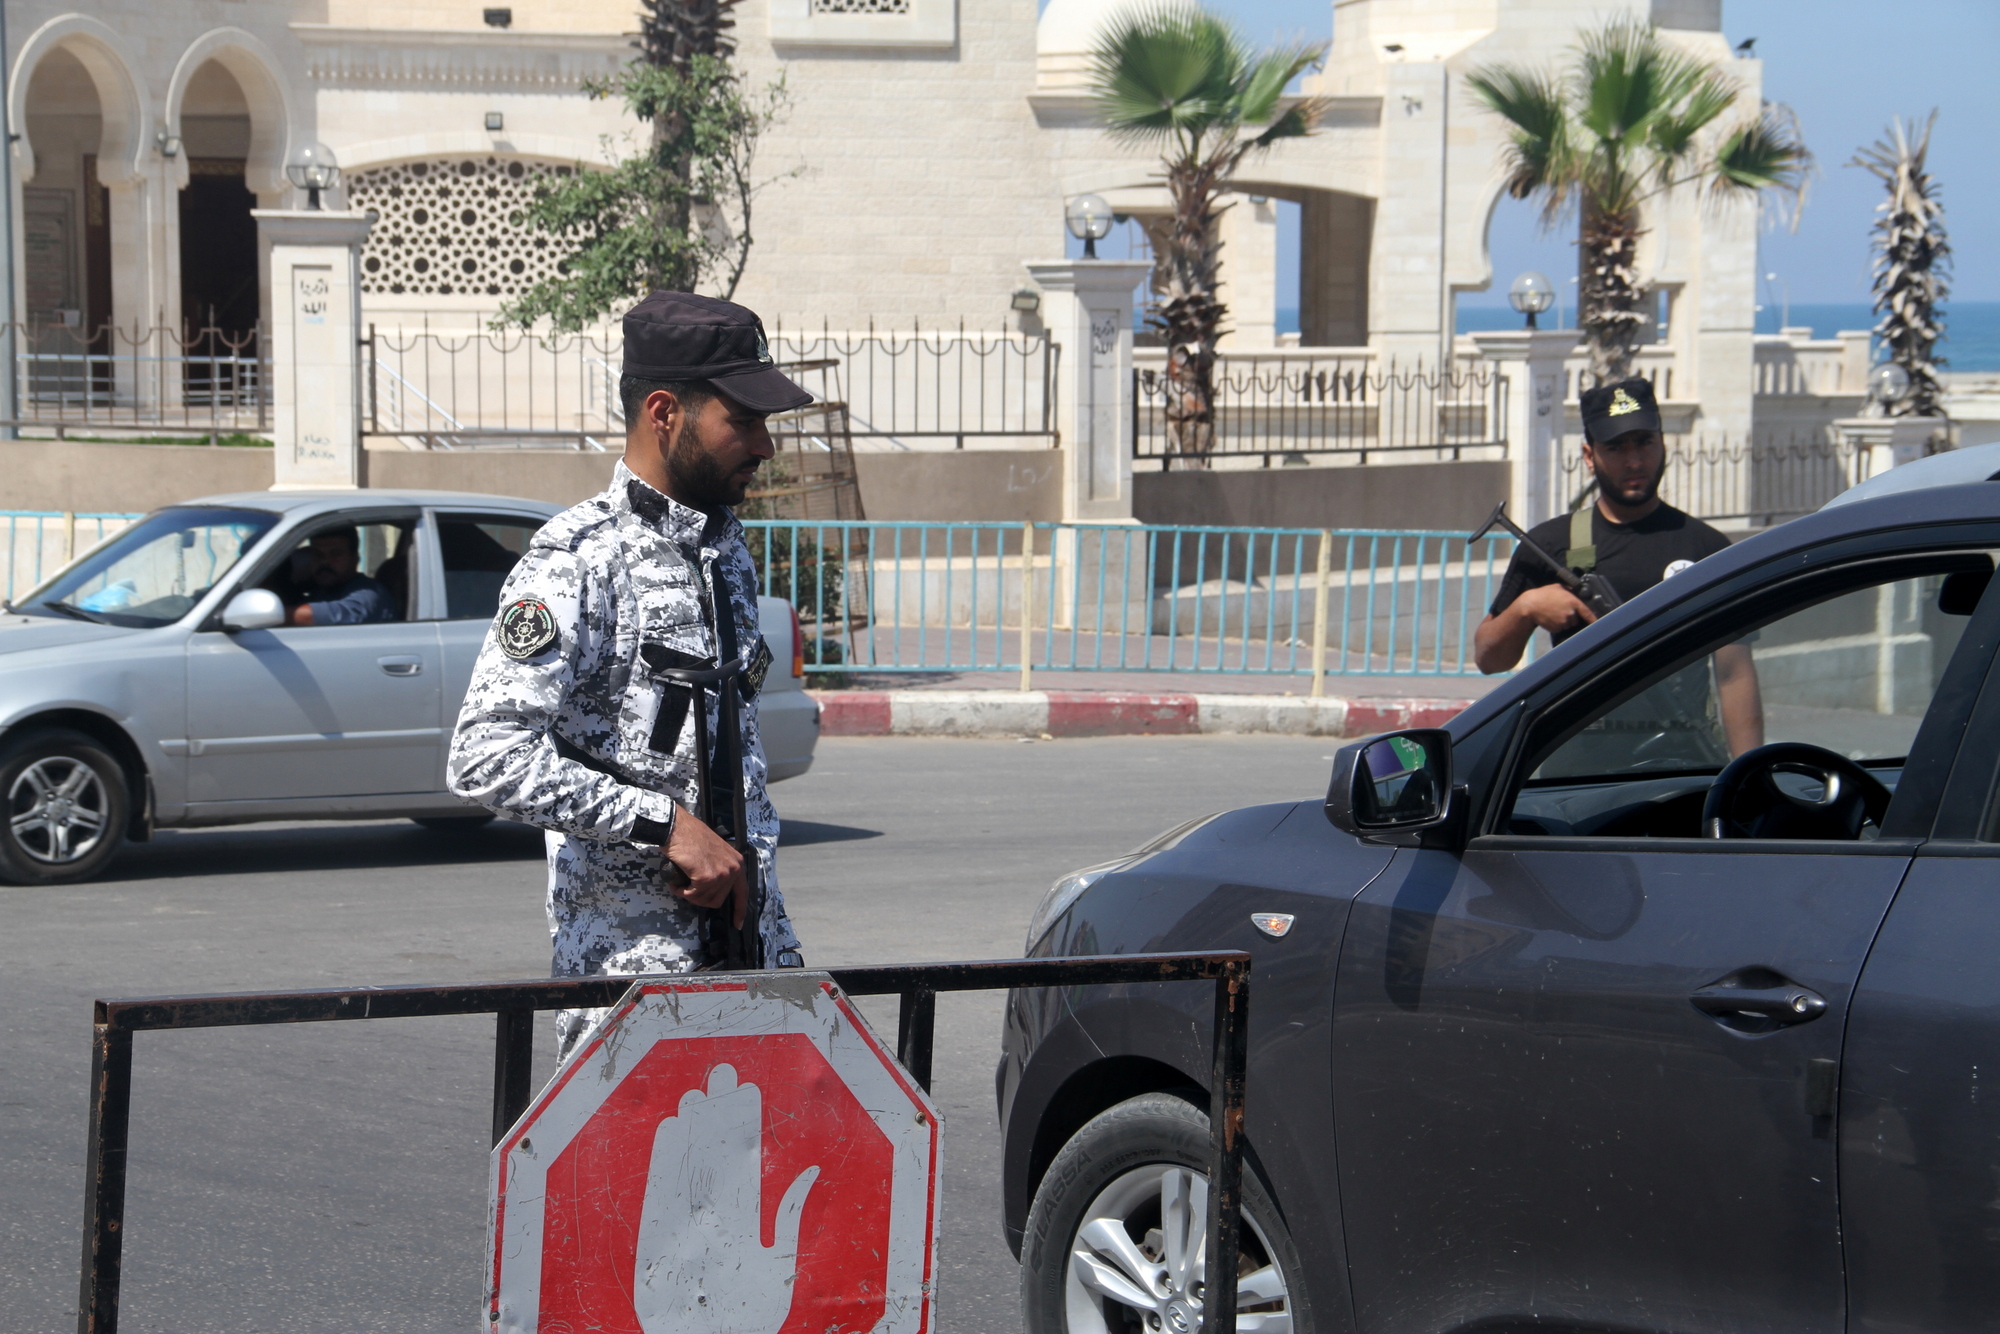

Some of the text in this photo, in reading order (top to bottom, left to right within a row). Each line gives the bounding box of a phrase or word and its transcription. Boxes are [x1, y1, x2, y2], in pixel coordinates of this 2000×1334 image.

[300, 301, 327, 315] الله
[1093, 341, 1114, 355] الله
[1036, 1149, 1092, 1241] LASSA
